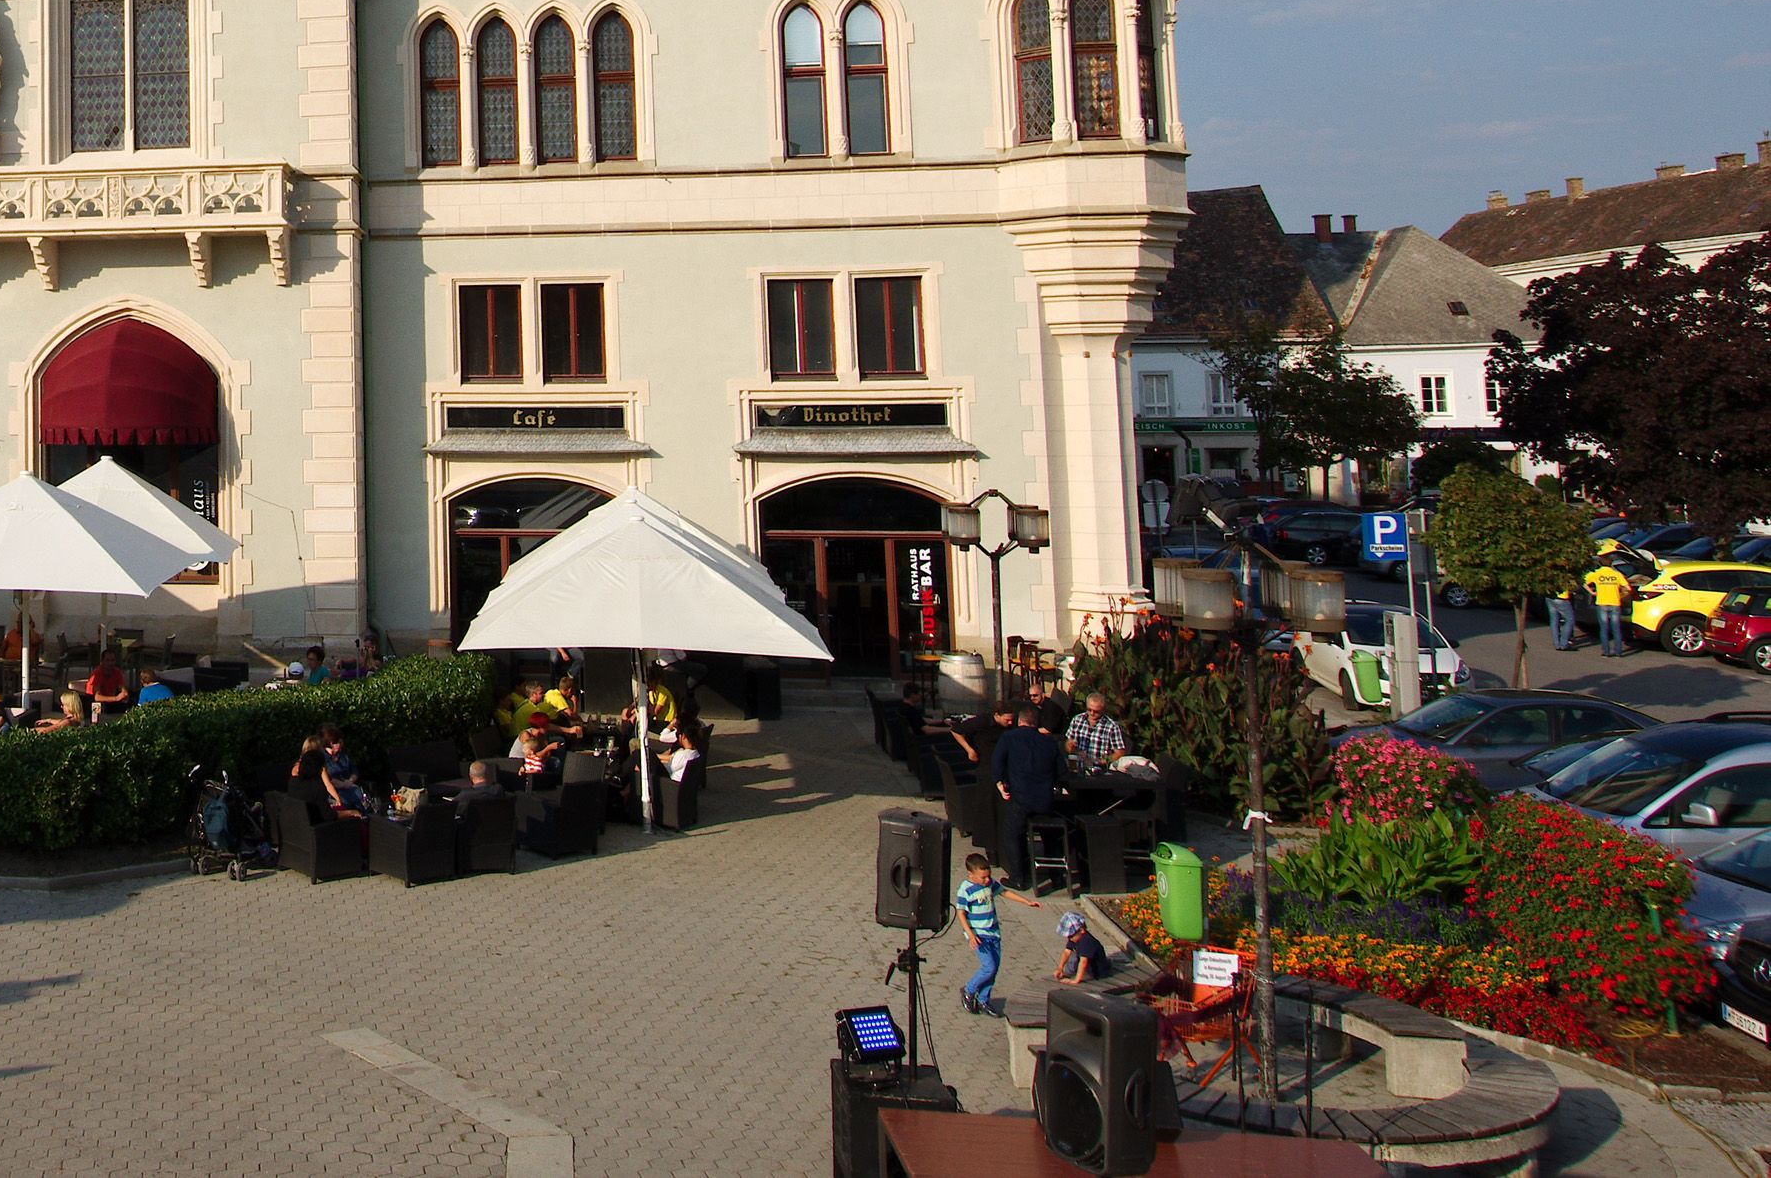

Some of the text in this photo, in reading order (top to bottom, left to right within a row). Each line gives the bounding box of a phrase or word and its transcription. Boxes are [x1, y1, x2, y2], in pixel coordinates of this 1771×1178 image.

[512, 410, 556, 428] Café
[803, 406, 892, 425] Vinothek
[1134, 422, 1247, 430] EISCH INKOST
[1373, 515, 1398, 544] P
[909, 548, 919, 601] RATHAUS
